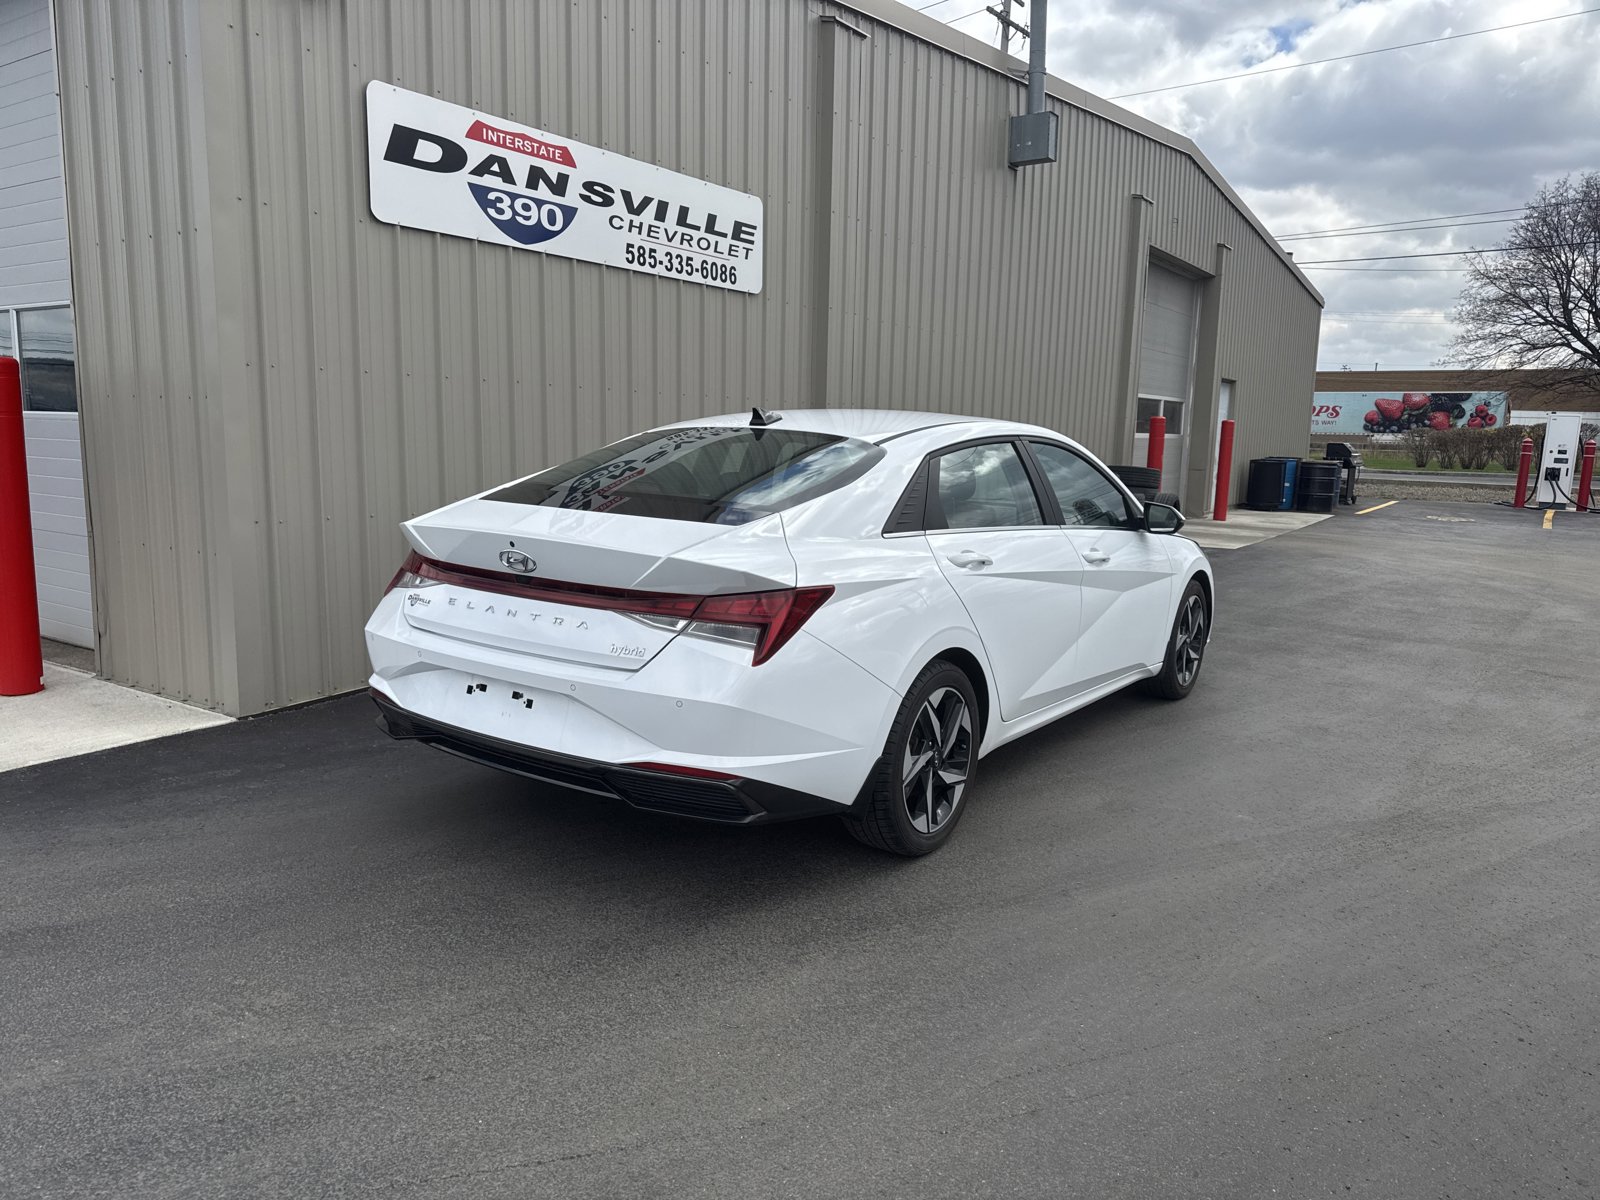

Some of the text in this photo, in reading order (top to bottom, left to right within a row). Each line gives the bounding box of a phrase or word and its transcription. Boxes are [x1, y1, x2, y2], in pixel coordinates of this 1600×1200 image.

[482, 127, 563, 162] INTERSTATE
[383, 123, 758, 246] DANSVILLE
[486, 190, 564, 232] 390
[608, 214, 754, 261] CHEVROLET
[625, 242, 738, 286] 585-335-6086
[448, 597, 589, 630] ELANTRA
[610, 643, 646, 658] hybrid
